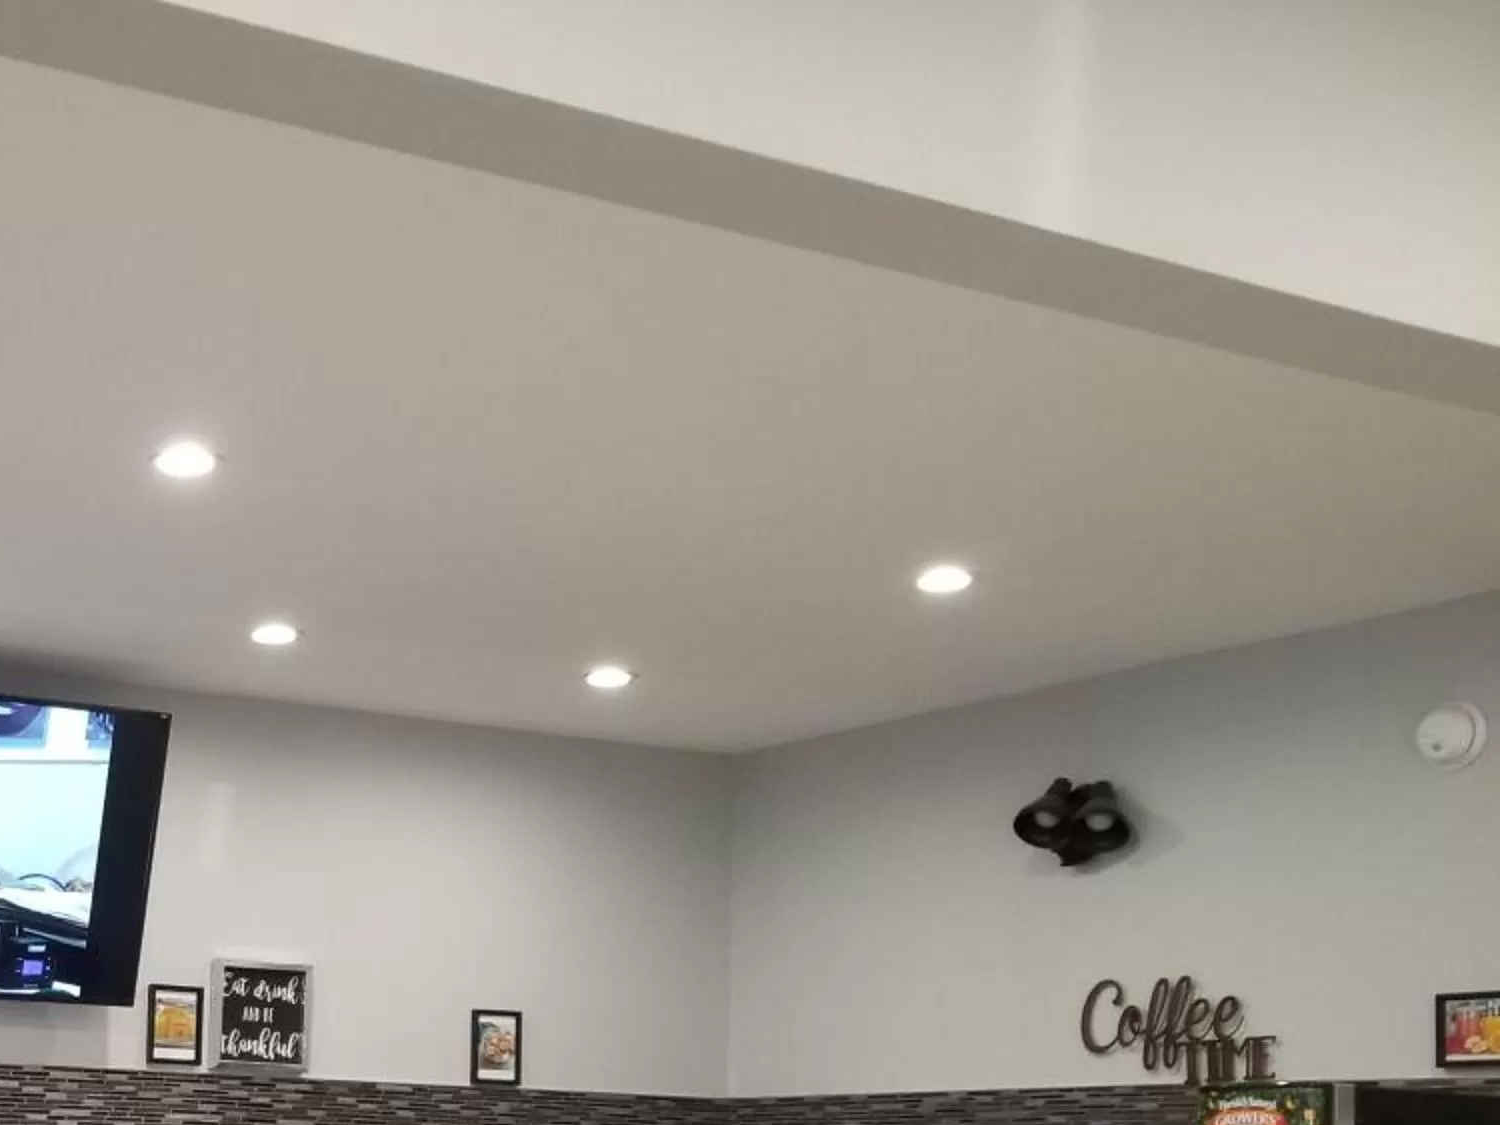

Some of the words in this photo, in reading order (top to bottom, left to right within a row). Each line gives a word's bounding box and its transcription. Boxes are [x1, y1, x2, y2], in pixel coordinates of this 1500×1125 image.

[221, 1028, 299, 1061] thankful
[1081, 975, 1245, 1071] Coffee
[1176, 1035, 1276, 1085] TIME
